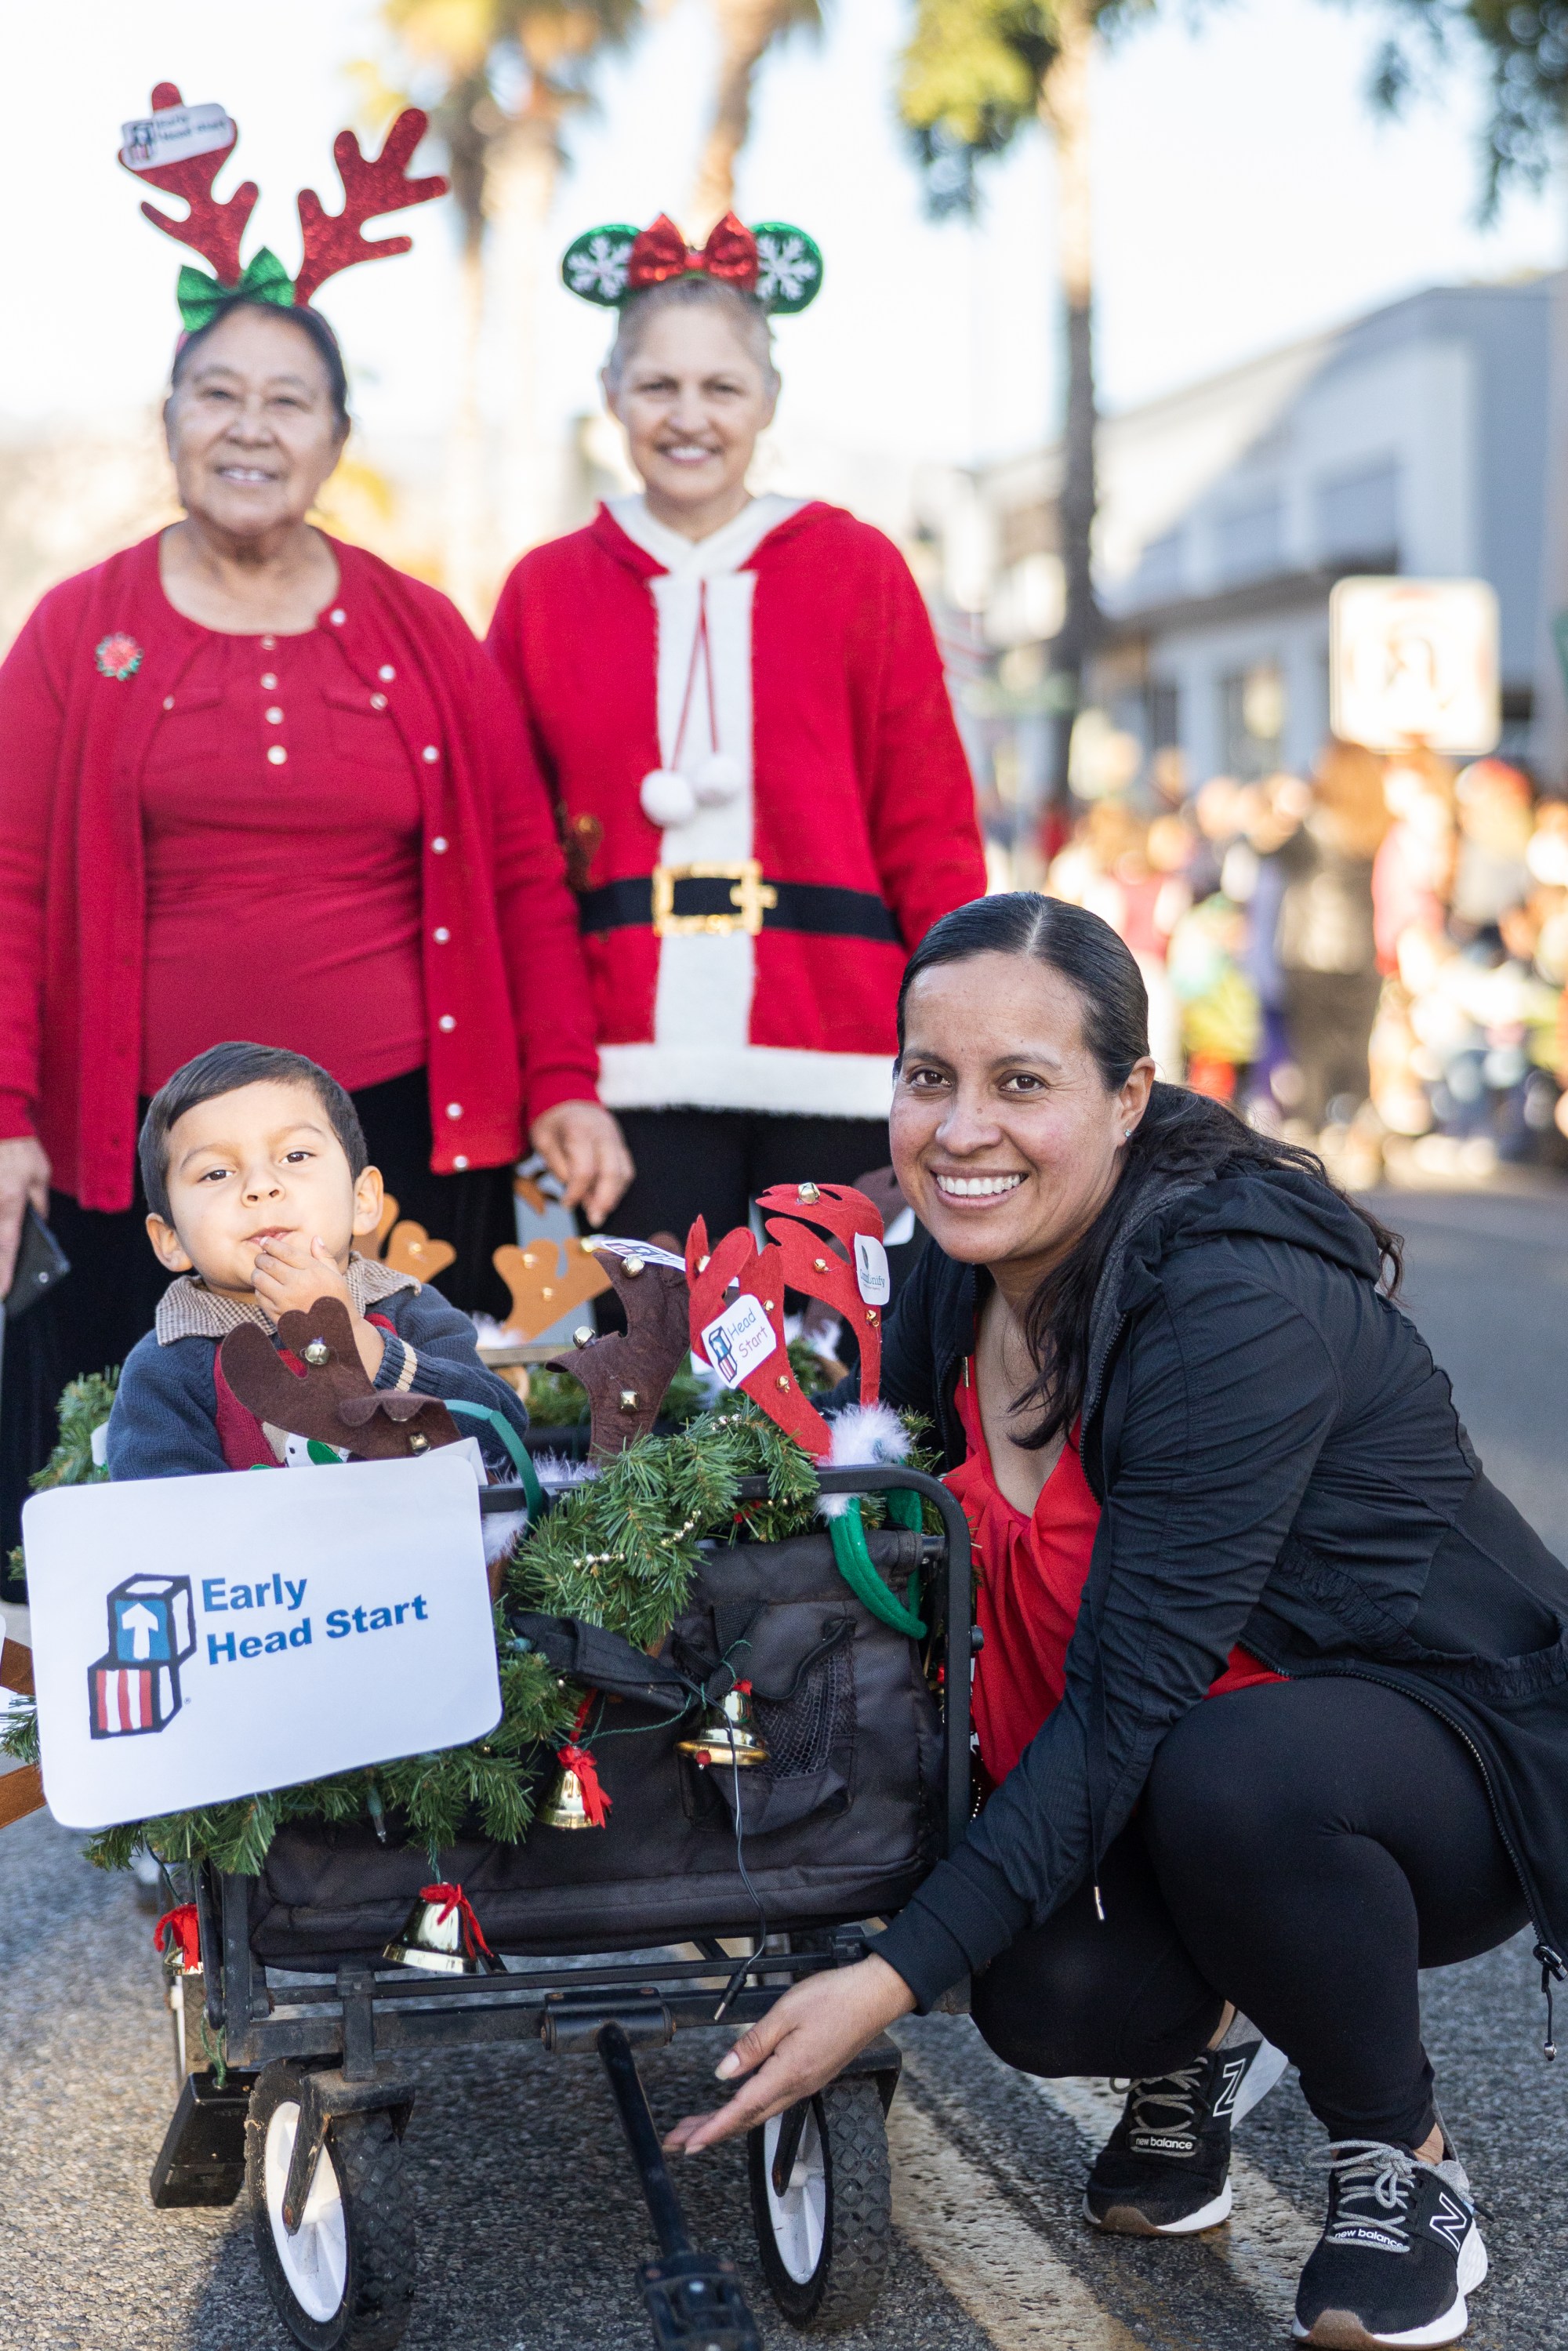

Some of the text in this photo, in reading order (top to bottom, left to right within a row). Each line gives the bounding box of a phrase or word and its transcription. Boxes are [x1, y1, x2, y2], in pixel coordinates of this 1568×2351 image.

[727, 1307, 757, 1341] Head
[739, 1326, 768, 1358] Start
[201, 1573, 308, 1613] Early
[207, 1594, 429, 1666] Head Start
[1150, 2136, 1193, 2150] balance
[1334, 2229, 1357, 2239] new
